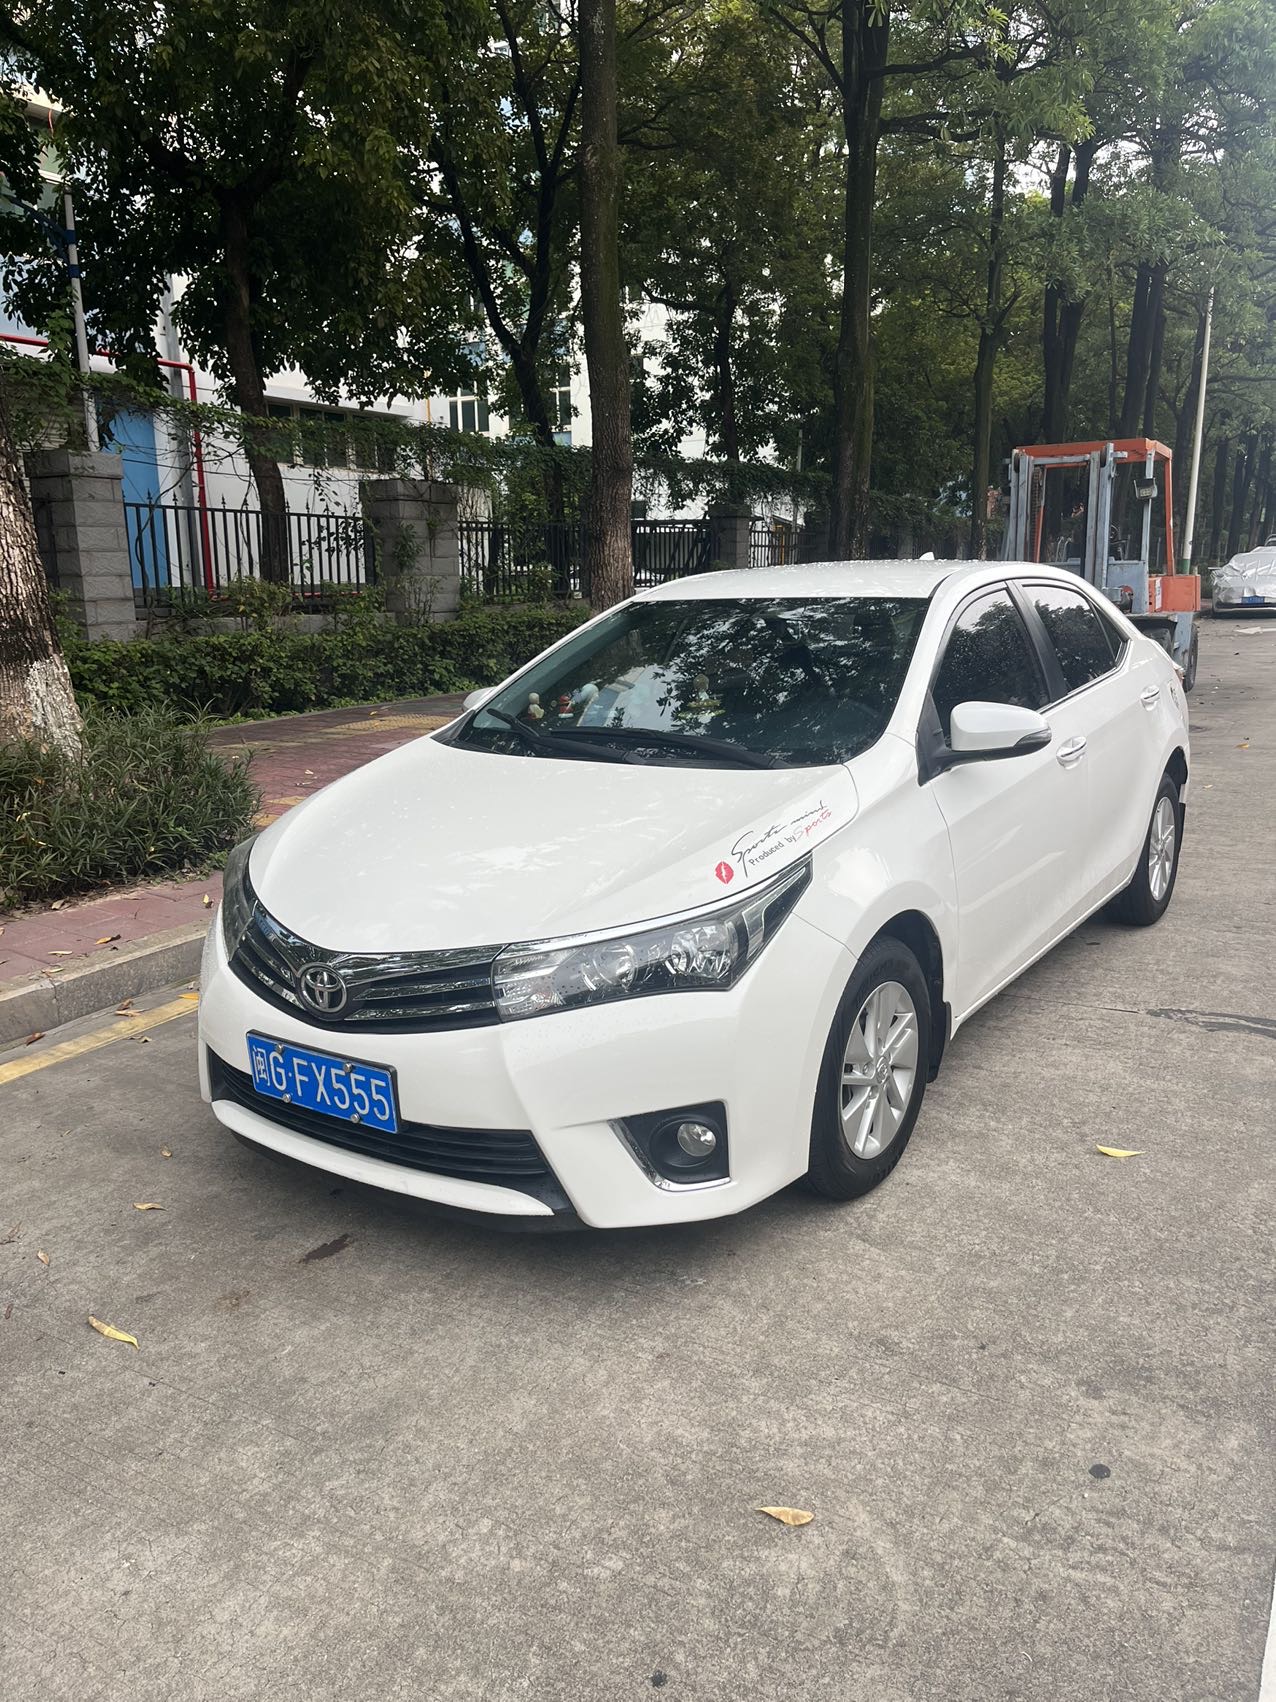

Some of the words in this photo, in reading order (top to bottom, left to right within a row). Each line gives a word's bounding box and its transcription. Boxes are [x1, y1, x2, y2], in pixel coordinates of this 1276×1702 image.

[748, 842, 785, 866] Produced
[785, 834, 798, 844] by
[794, 808, 832, 839] Sports
